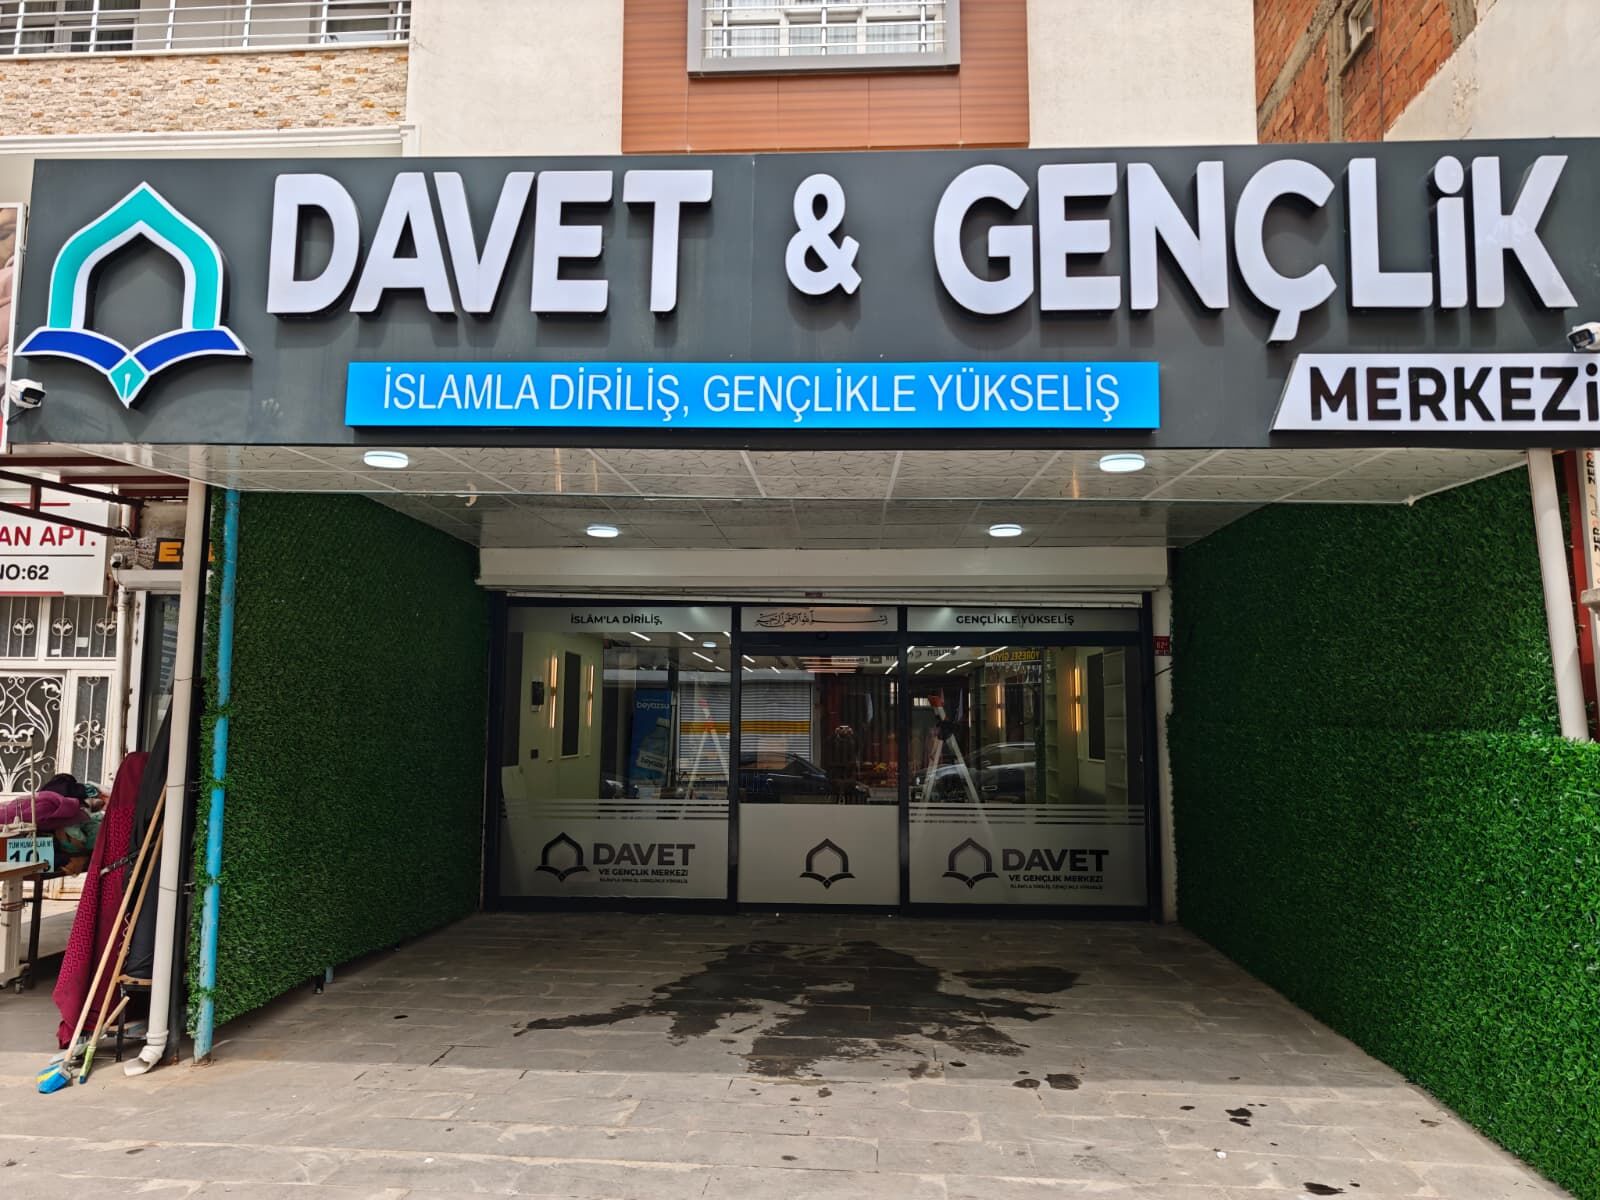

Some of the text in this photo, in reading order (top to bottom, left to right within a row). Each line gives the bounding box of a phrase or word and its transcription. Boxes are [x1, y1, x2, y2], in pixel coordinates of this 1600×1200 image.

[267, 155, 1579, 343] DAVET & GENÇLİK
[382, 366, 1121, 422] İSLAMLA DİRİLİŞ, GENÇLİKLE YÜKSELİŞ
[1309, 363, 1600, 422] MERKEZİ
[955, 613, 1018, 627] GENÇLİKLE
[593, 843, 696, 866] DAVET
[1002, 848, 1109, 872] DAVET
